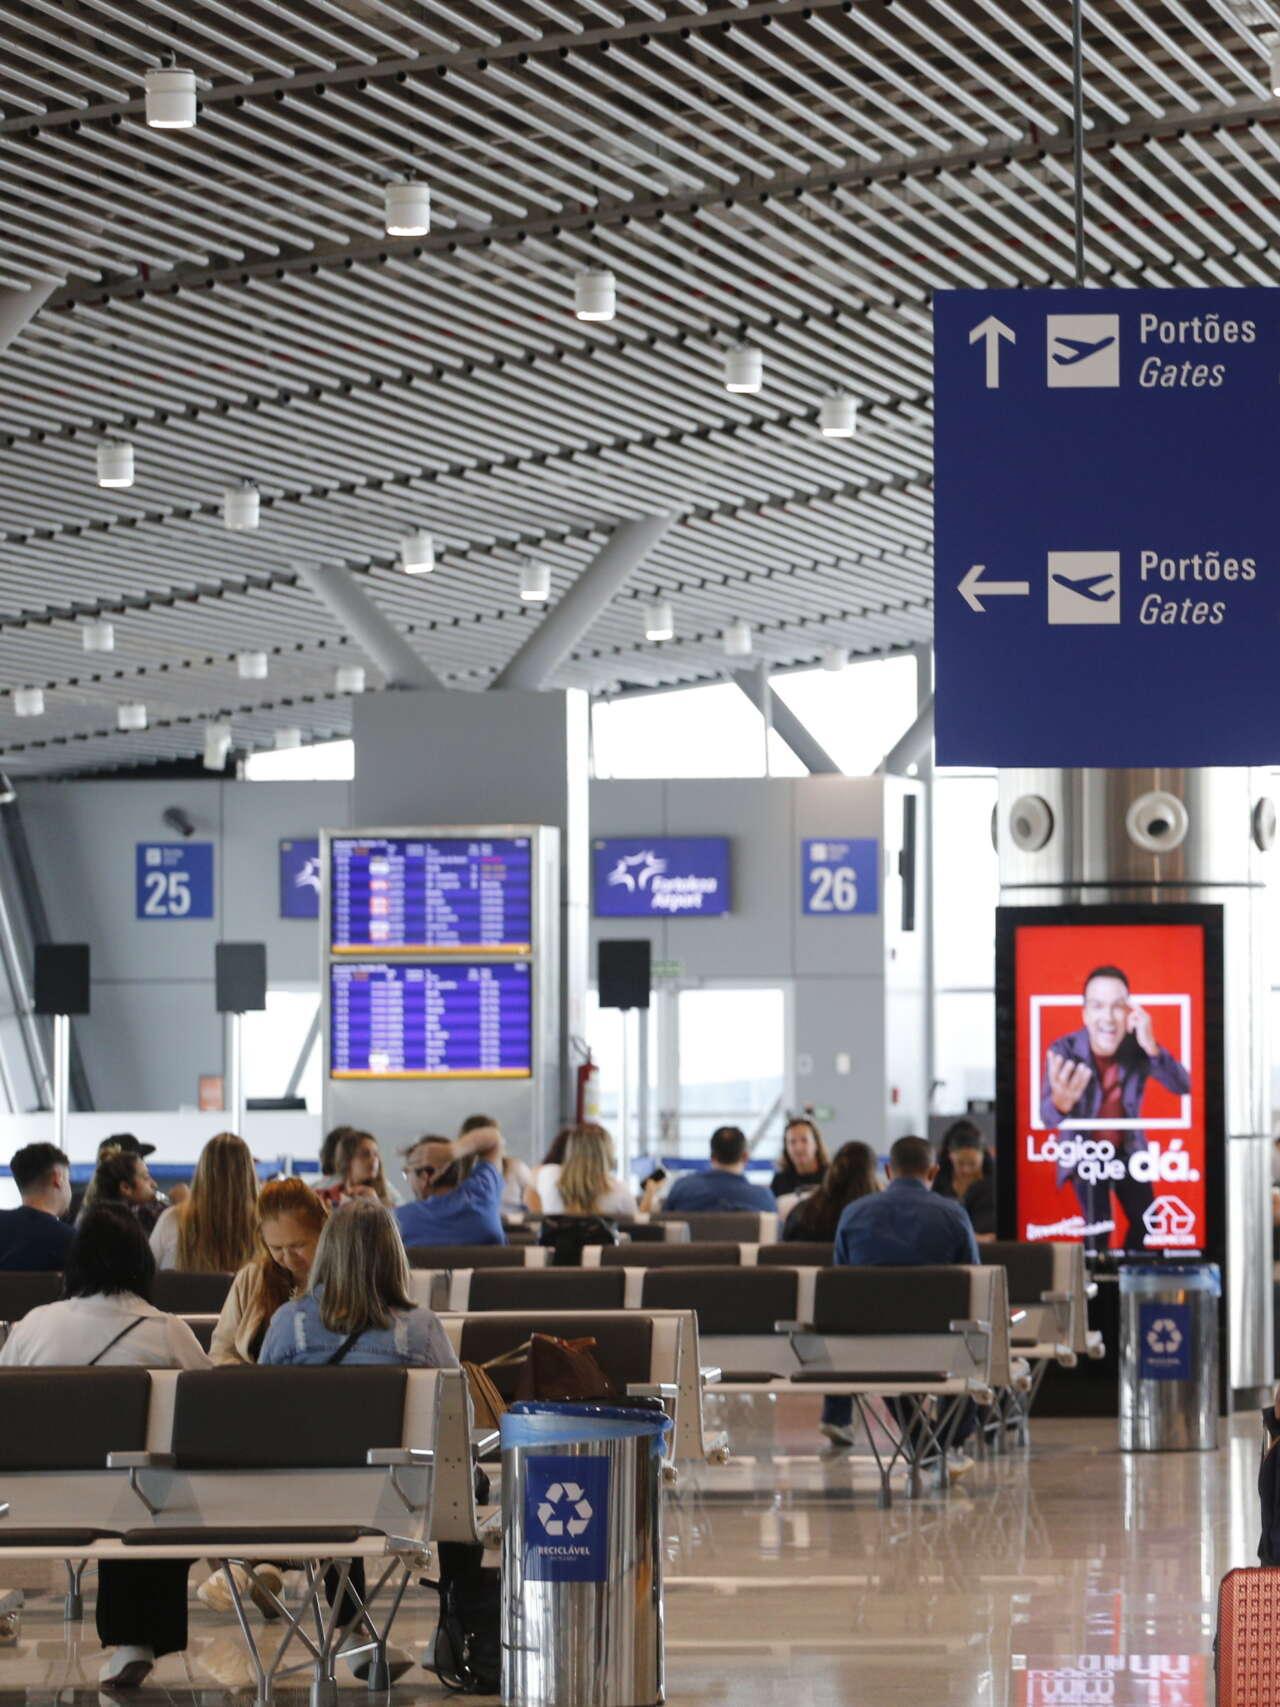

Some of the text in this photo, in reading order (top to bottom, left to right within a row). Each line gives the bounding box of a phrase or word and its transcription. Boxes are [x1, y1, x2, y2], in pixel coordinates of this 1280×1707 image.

[1140, 313, 1256, 344] Portões
[1139, 357, 1226, 388] Gates
[1140, 550, 1256, 582] Portões
[1139, 594, 1226, 625] Gates
[145, 872, 191, 915] 25
[809, 867, 857, 911] 26
[1026, 1134, 1116, 1168] Lógico
[1077, 1138, 1200, 1185] que dá.
[538, 1545, 590, 1555] RECICLÁVEL
